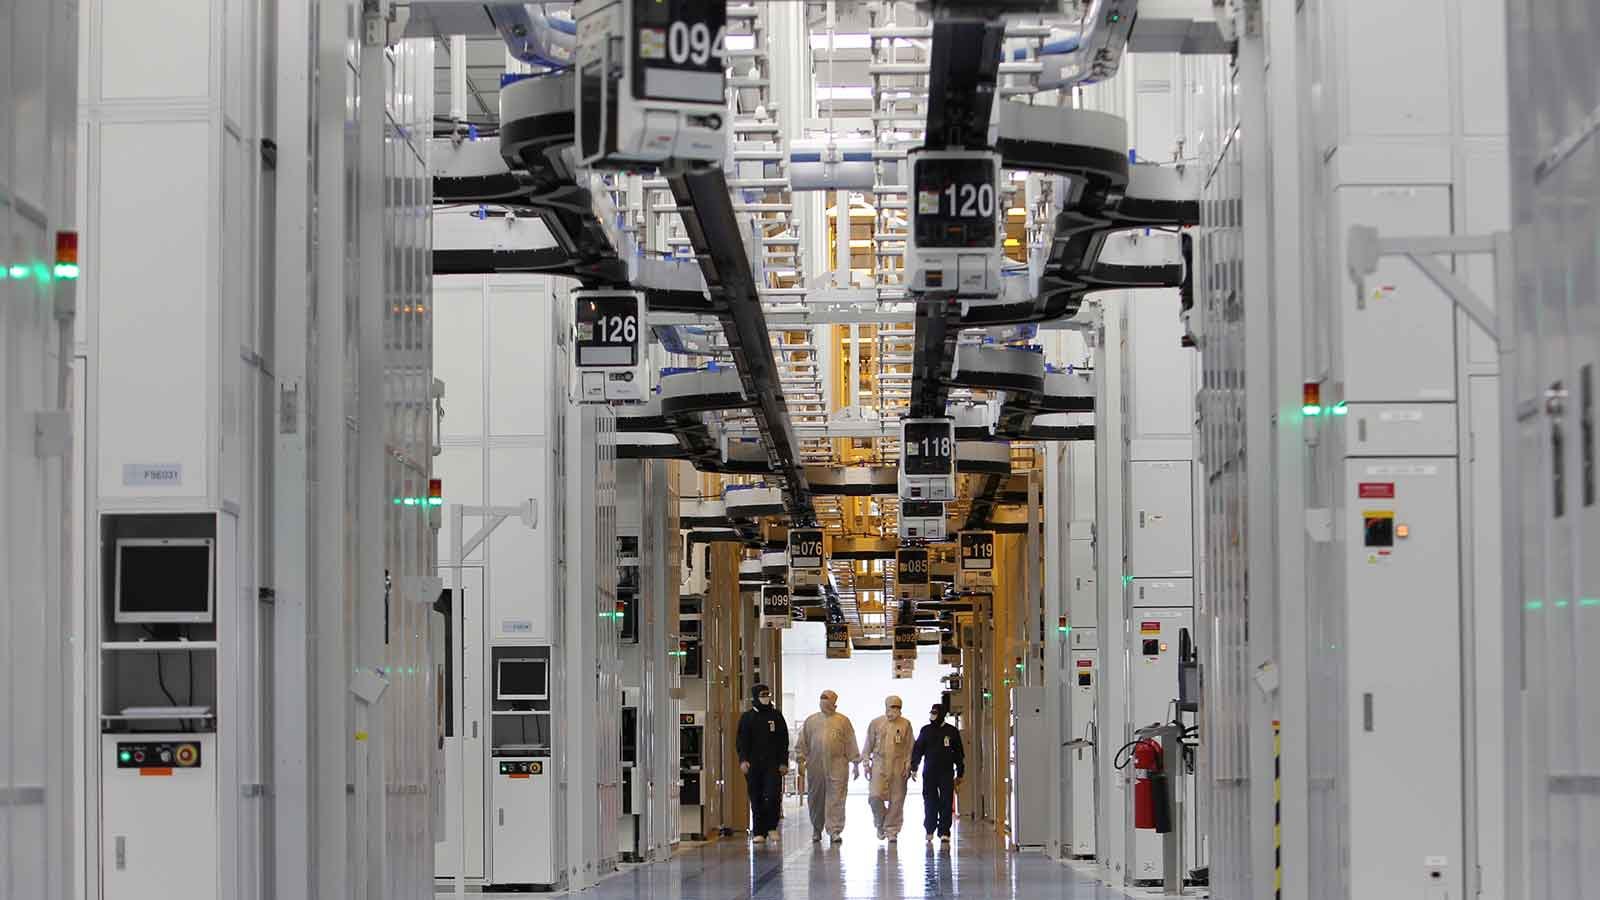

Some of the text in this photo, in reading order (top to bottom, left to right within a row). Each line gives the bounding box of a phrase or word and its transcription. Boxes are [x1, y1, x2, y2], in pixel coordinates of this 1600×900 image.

[669, 21, 727, 65] 094
[945, 183, 993, 217] 120
[598, 315, 636, 342] 126
[922, 437, 950, 457] 118
[801, 542, 822, 555] 076
[973, 543, 992, 557] 119
[908, 560, 928, 573] 085
[771, 594, 788, 606] 099
